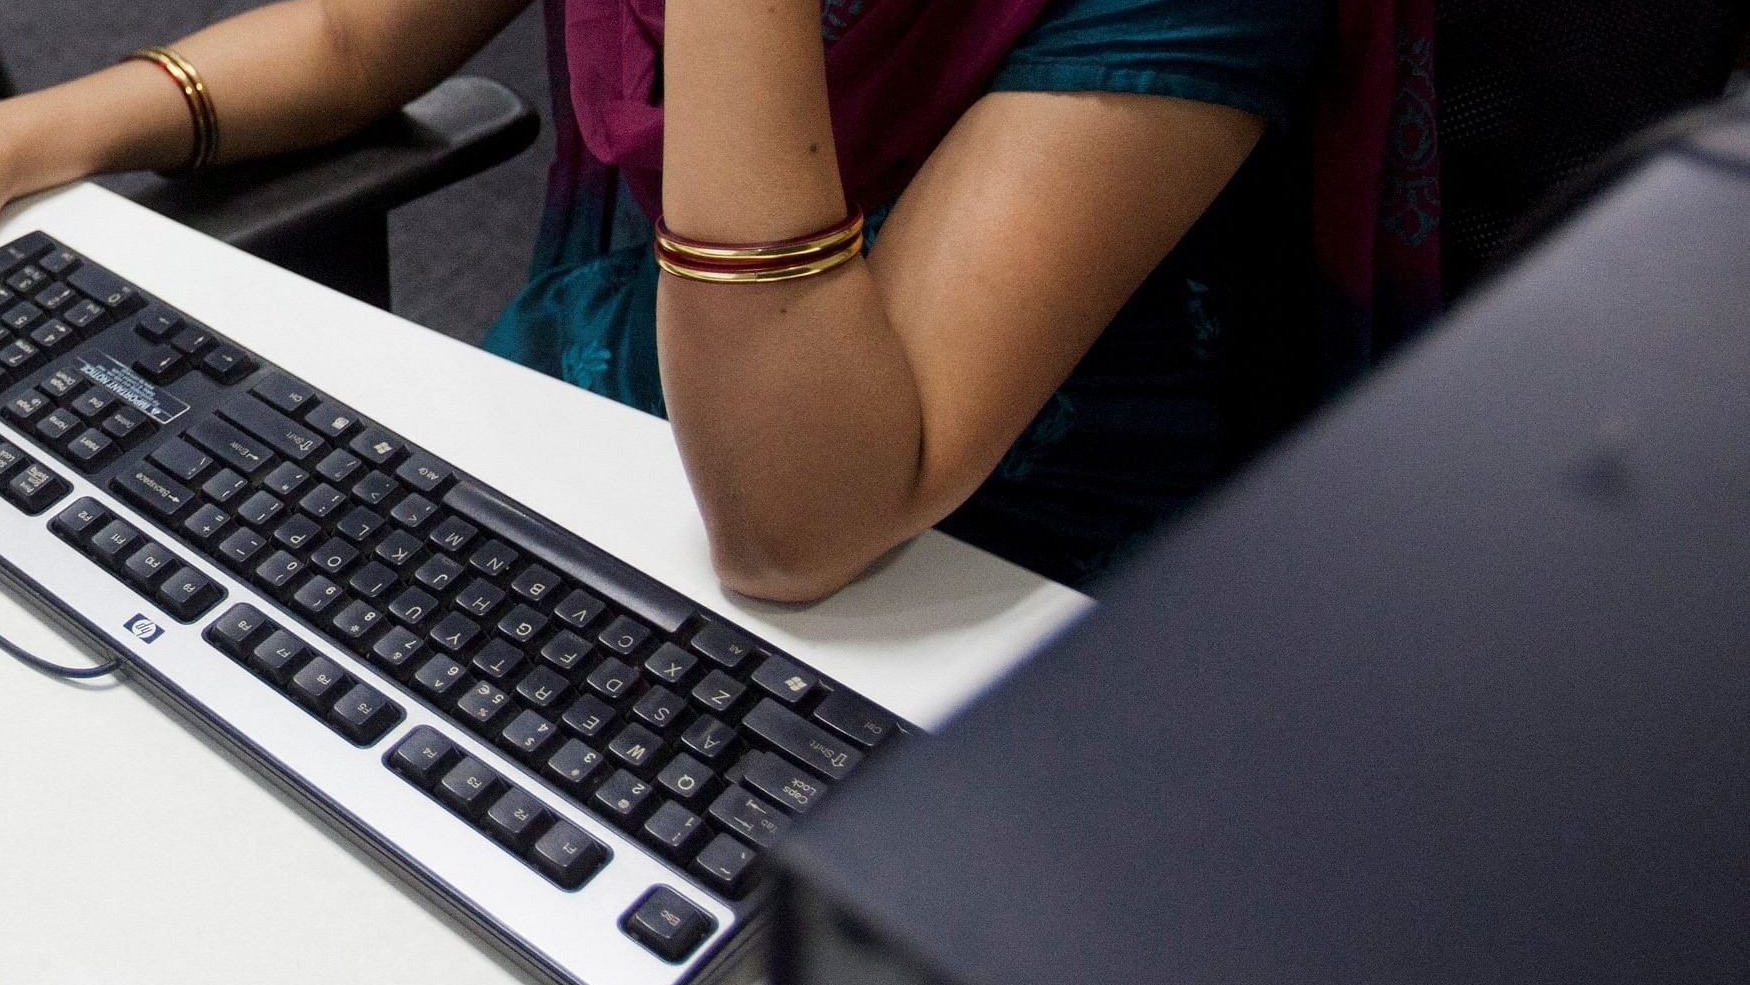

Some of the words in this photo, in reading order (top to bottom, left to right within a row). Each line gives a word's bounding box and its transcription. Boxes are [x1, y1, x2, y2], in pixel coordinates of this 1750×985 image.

[107, 293, 121, 304] 0
[55, 371, 76, 386] Down
[80, 363, 110, 384] NOTICE
[50, 378, 67, 391] Page
[88, 396, 104, 409] End
[105, 381, 151, 410] IMPORTANT
[16, 399, 34, 413] Page
[48, 415, 68, 430] Home
[114, 413, 135, 428] Delete
[79, 436, 100, 452] Insert
[285, 431, 305, 444] Shift
[229, 441, 250, 456] Enter
[19, 481, 35, 493] Print
[135, 472, 171, 498] Backspace
[77, 510, 93, 522] F12
[358, 523, 370, 537] L
[110, 533, 126, 545] F11
[289, 534, 306, 544] P
[444, 532, 464, 547] M
[391, 547, 409, 561] K
[144, 556, 161, 568] F10
[326, 555, 342, 568] O
[486, 557, 504, 571] N
[432, 573, 449, 584] J
[529, 583, 546, 596] B
[471, 596, 491, 611] H
[404, 606, 422, 620] U
[572, 609, 587, 622] V
[237, 620, 252, 631] F8
[515, 622, 533, 637] G
[445, 632, 461, 646] Y
[617, 635, 634, 649] C
[275, 647, 291, 658] F7
[728, 644, 743, 655] Alt
[489, 659, 505, 672] T
[559, 653, 578, 664] F
[663, 662, 683, 677] X
[316, 673, 332, 686] F6
[605, 678, 624, 693] D
[477, 684, 491, 695] €
[534, 685, 552, 701] R
[491, 693, 505, 704] 5
[710, 689, 731, 705] Z
[356, 702, 372, 715] F5
[653, 707, 670, 721] S
[582, 715, 600, 730] E
[863, 721, 883, 735] Ctrl
[703, 734, 720, 750] A
[422, 747, 437, 759] F4
[626, 744, 646, 760] W
[809, 740, 835, 759] Shift
[583, 752, 597, 764] 3
[465, 776, 482, 789] F3
[631, 783, 646, 795] 2
[677, 774, 695, 791] Q
[791, 777, 817, 797] Lock
[782, 785, 809, 805] Caps
[513, 807, 529, 821] F2
[760, 819, 778, 834] Tab
[562, 841, 578, 855] F1
[660, 909, 681, 927] Esc
